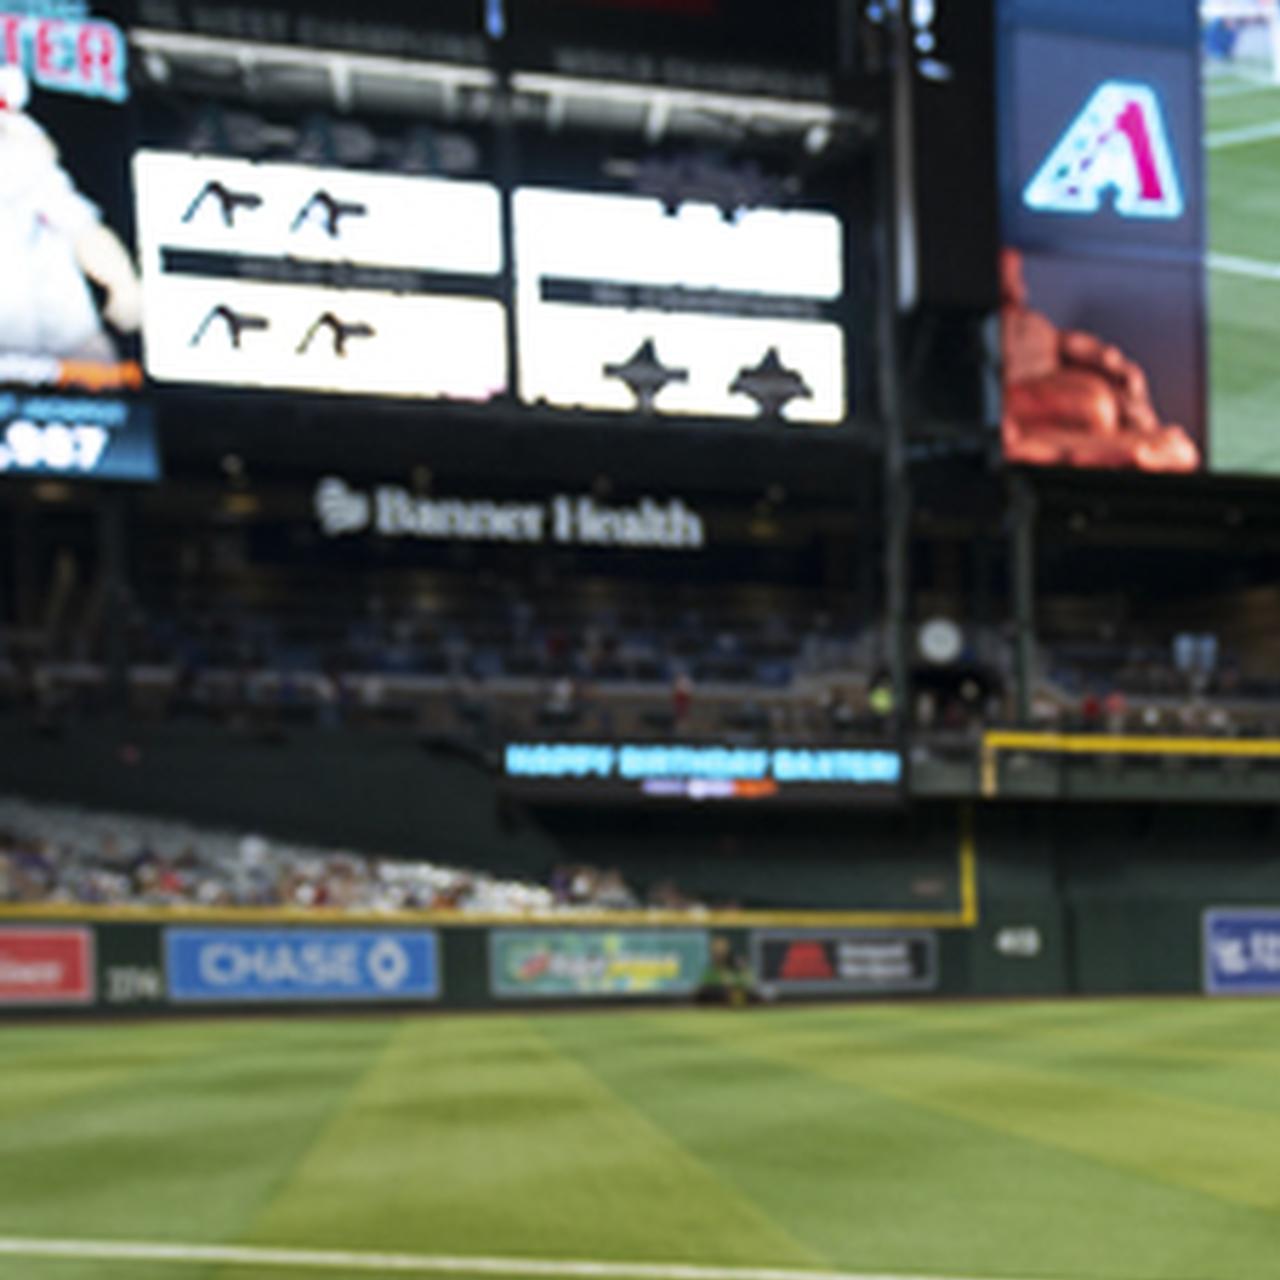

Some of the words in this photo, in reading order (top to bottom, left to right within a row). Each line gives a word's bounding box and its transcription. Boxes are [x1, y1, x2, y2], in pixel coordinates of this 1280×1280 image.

[376, 486, 543, 542] Banner
[553, 495, 704, 549] Health
[199, 942, 361, 986] CHASE
